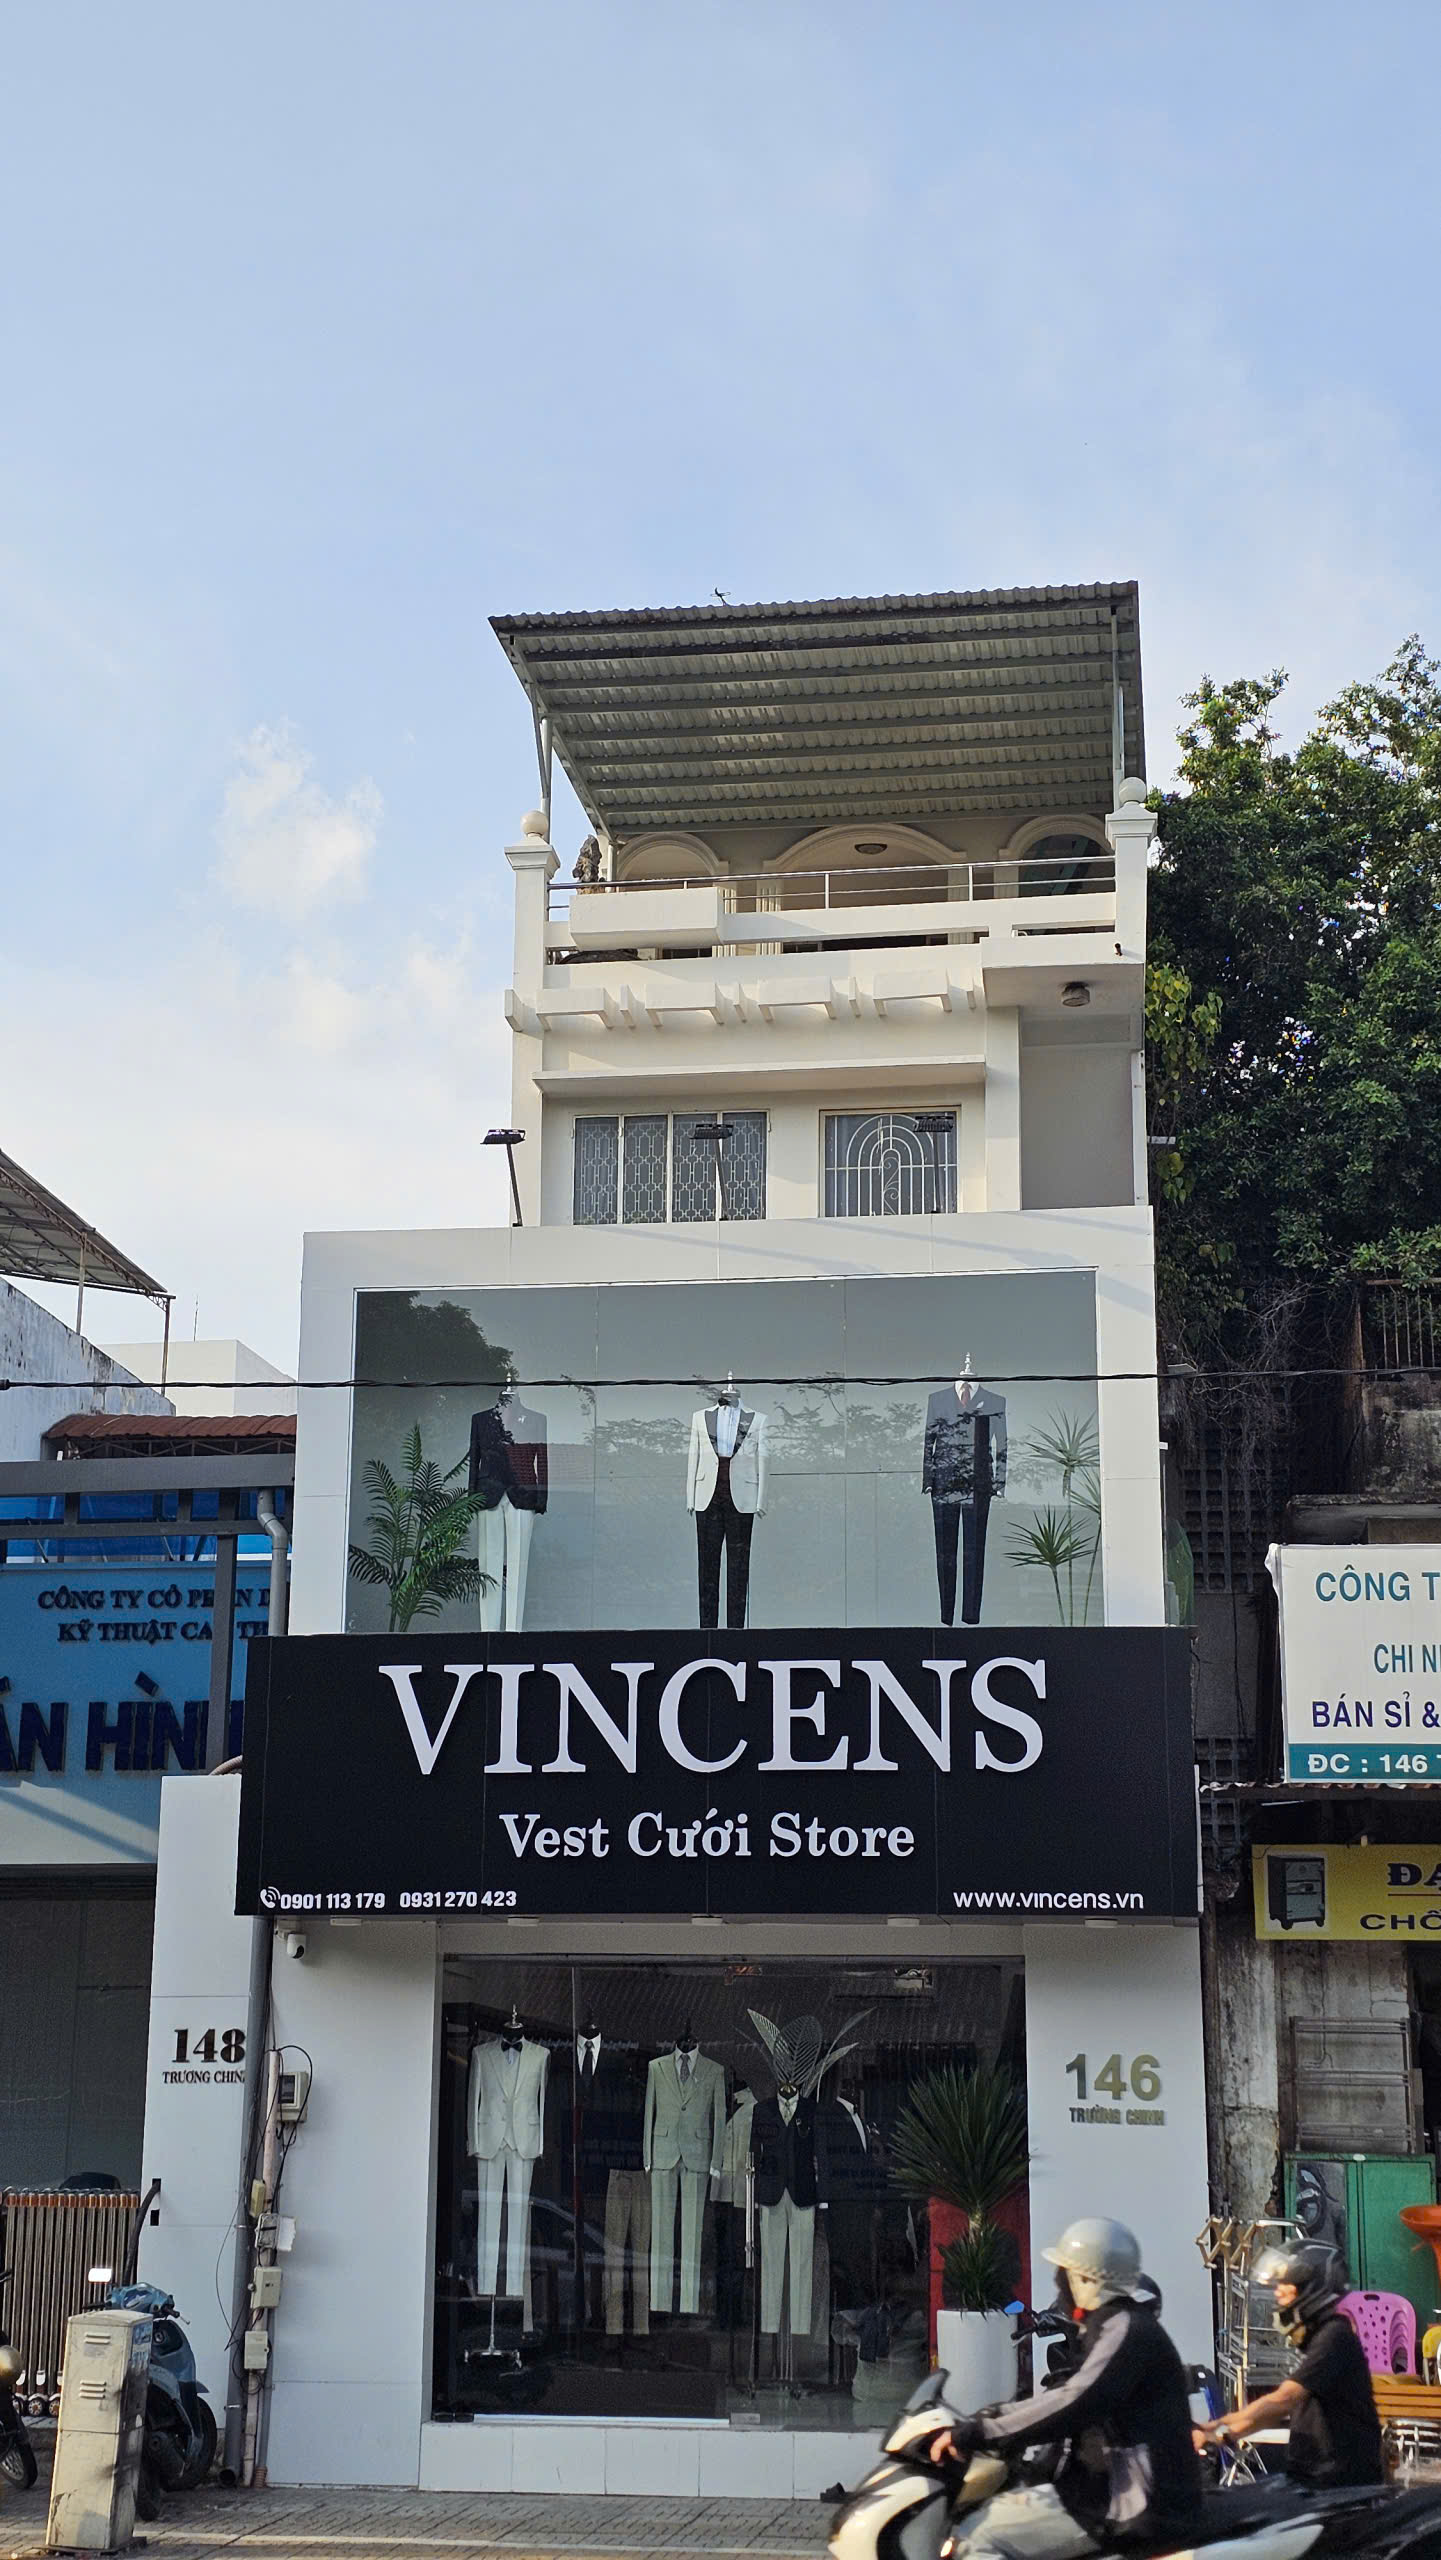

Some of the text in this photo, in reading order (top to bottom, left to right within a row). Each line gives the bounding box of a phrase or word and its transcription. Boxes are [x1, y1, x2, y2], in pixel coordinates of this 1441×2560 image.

[38, 1585, 104, 1609] CÔNG
[110, 1588, 144, 1609] TY
[188, 1588, 253, 1609] PHN
[1316, 1565, 1410, 1602] CÔNG
[58, 1618, 93, 1642] KỸ
[98, 1618, 177, 1645] THUẬT
[1374, 1643, 1441, 1673] CHI N
[378, 1656, 1047, 1776] VINCENS
[1312, 1691, 1441, 1728] BÁN SỈ &
[1308, 1753, 1350, 1773] ĐC
[1379, 1754, 1428, 1773] 146
[499, 1807, 915, 1858] Vest Cưới Store
[280, 1890, 517, 1909] 0901 113 179 0931 270 423
[953, 1892, 1144, 1909] www.vincens.vn
[172, 2028, 246, 2063] 148
[213, 2069, 246, 2084] CHIN
[1065, 2053, 1162, 2102] 146
